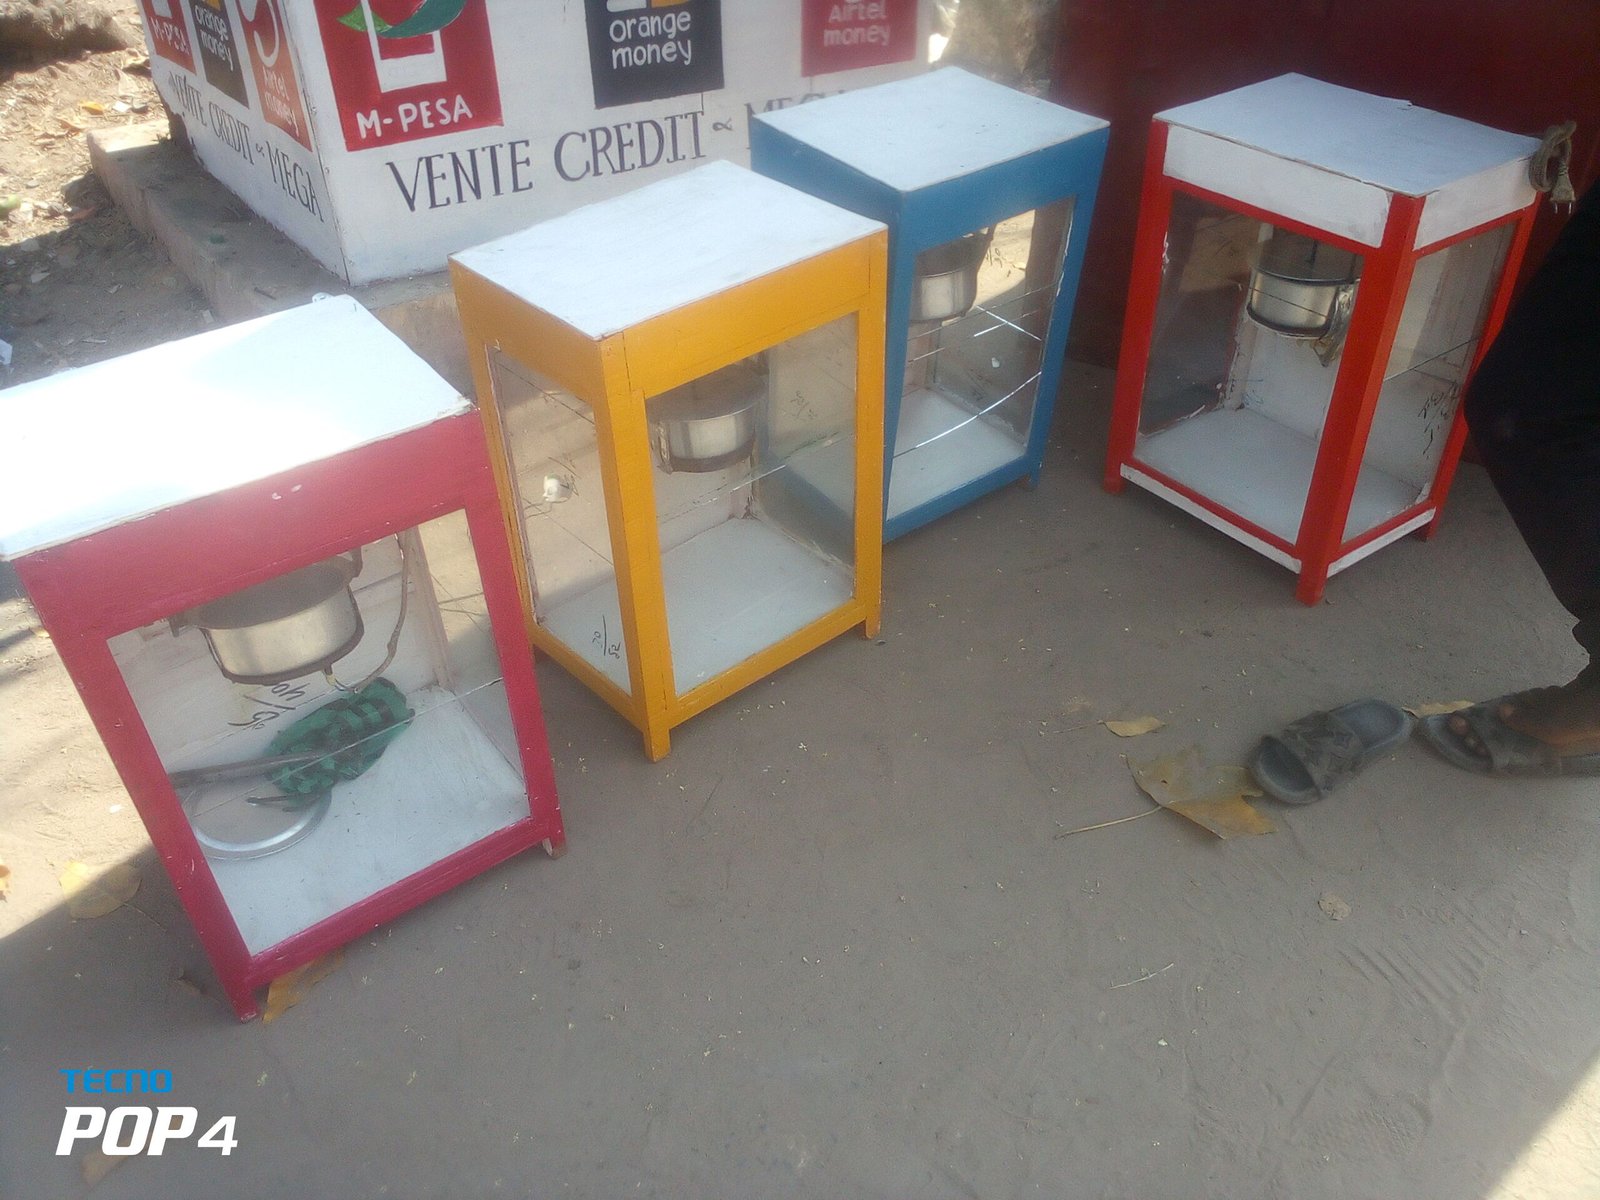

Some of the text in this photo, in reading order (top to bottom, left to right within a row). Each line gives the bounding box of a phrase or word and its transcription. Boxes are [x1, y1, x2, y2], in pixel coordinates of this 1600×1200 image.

[609, 10, 692, 42] orange
[823, 24, 892, 47] money
[611, 39, 692, 70] money
[355, 95, 474, 139] M-PESA
[208, 101, 255, 166] CREDIT
[265, 140, 324, 223] MEGA
[384, 139, 533, 212] VENTE
[553, 110, 707, 182] CREDIT
